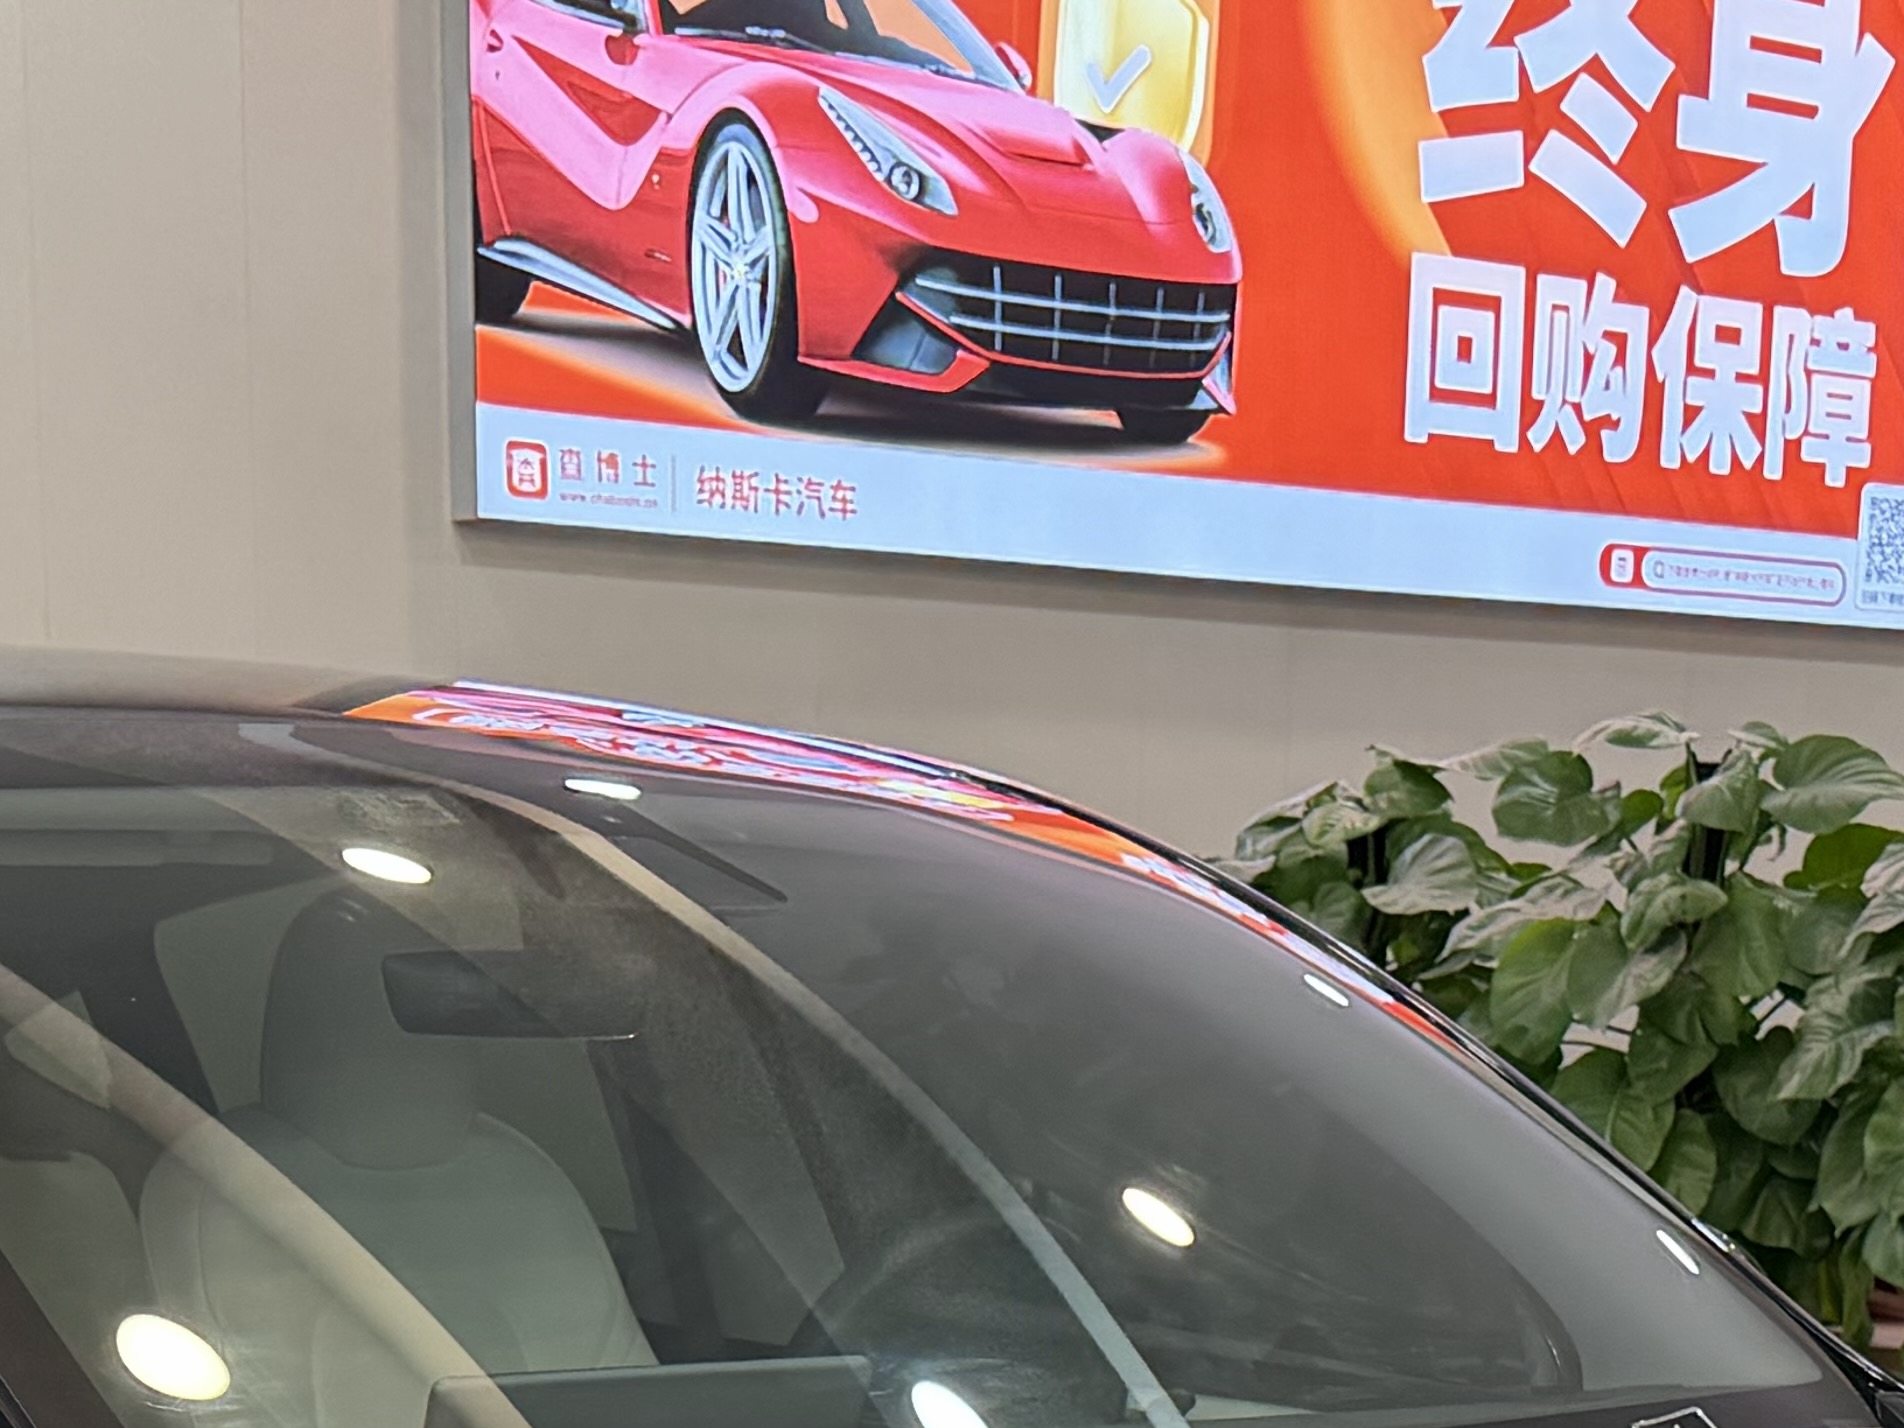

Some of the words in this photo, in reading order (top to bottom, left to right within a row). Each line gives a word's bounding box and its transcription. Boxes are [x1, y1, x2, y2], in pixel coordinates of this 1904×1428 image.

[1418, 0, 1896, 277] 终身
[1404, 252, 1878, 488] 回购保障
[697, 465, 858, 520] 纳斯卡汽车
